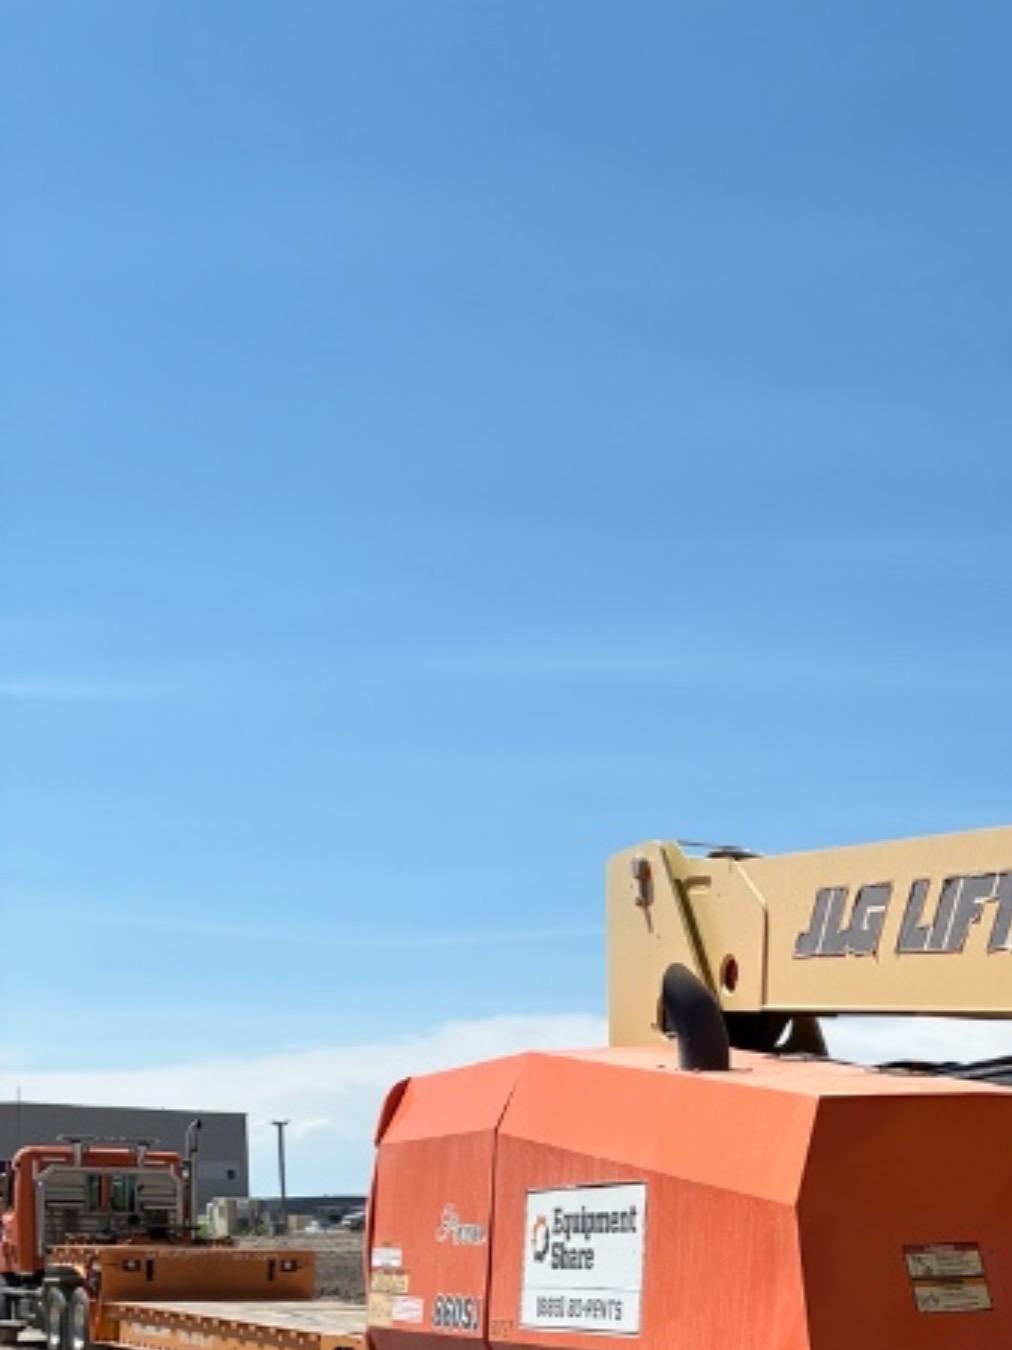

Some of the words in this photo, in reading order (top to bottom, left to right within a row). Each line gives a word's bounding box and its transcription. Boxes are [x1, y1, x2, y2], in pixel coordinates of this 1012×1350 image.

[793, 881, 894, 958] JLG
[552, 1205, 636, 1241] Equipment
[551, 1241, 594, 1270] Share
